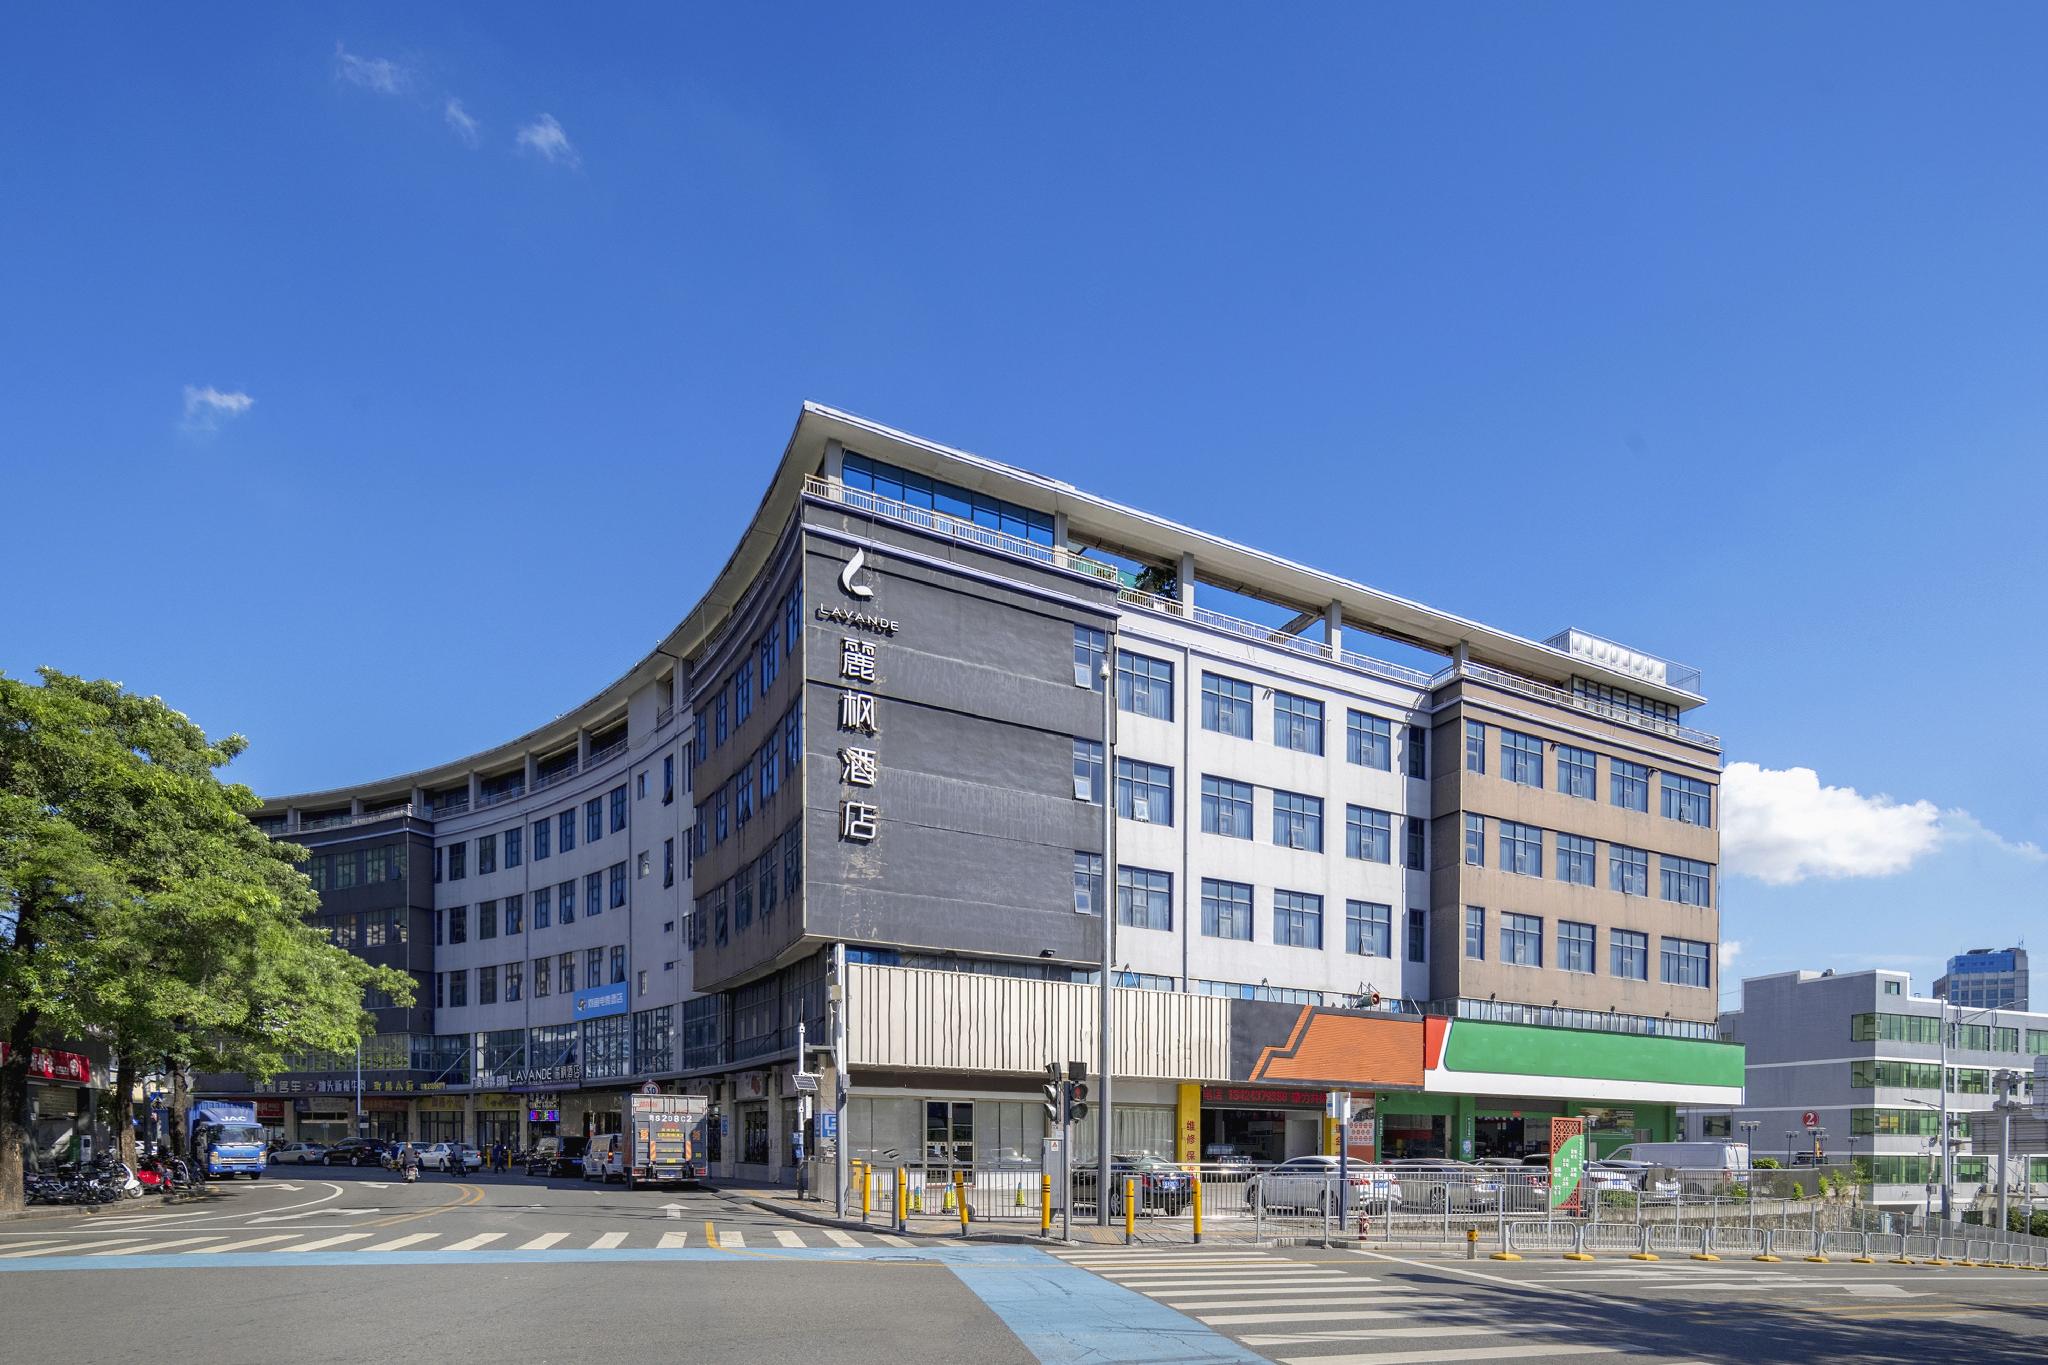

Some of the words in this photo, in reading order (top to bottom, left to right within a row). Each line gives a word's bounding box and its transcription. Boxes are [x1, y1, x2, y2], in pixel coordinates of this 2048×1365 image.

[820, 602, 899, 632] LAVANDE
[842, 636, 877, 840] 麗枫酒店
[509, 1068, 552, 1081] LAVANDE
[1806, 1112, 1815, 1125] 2
